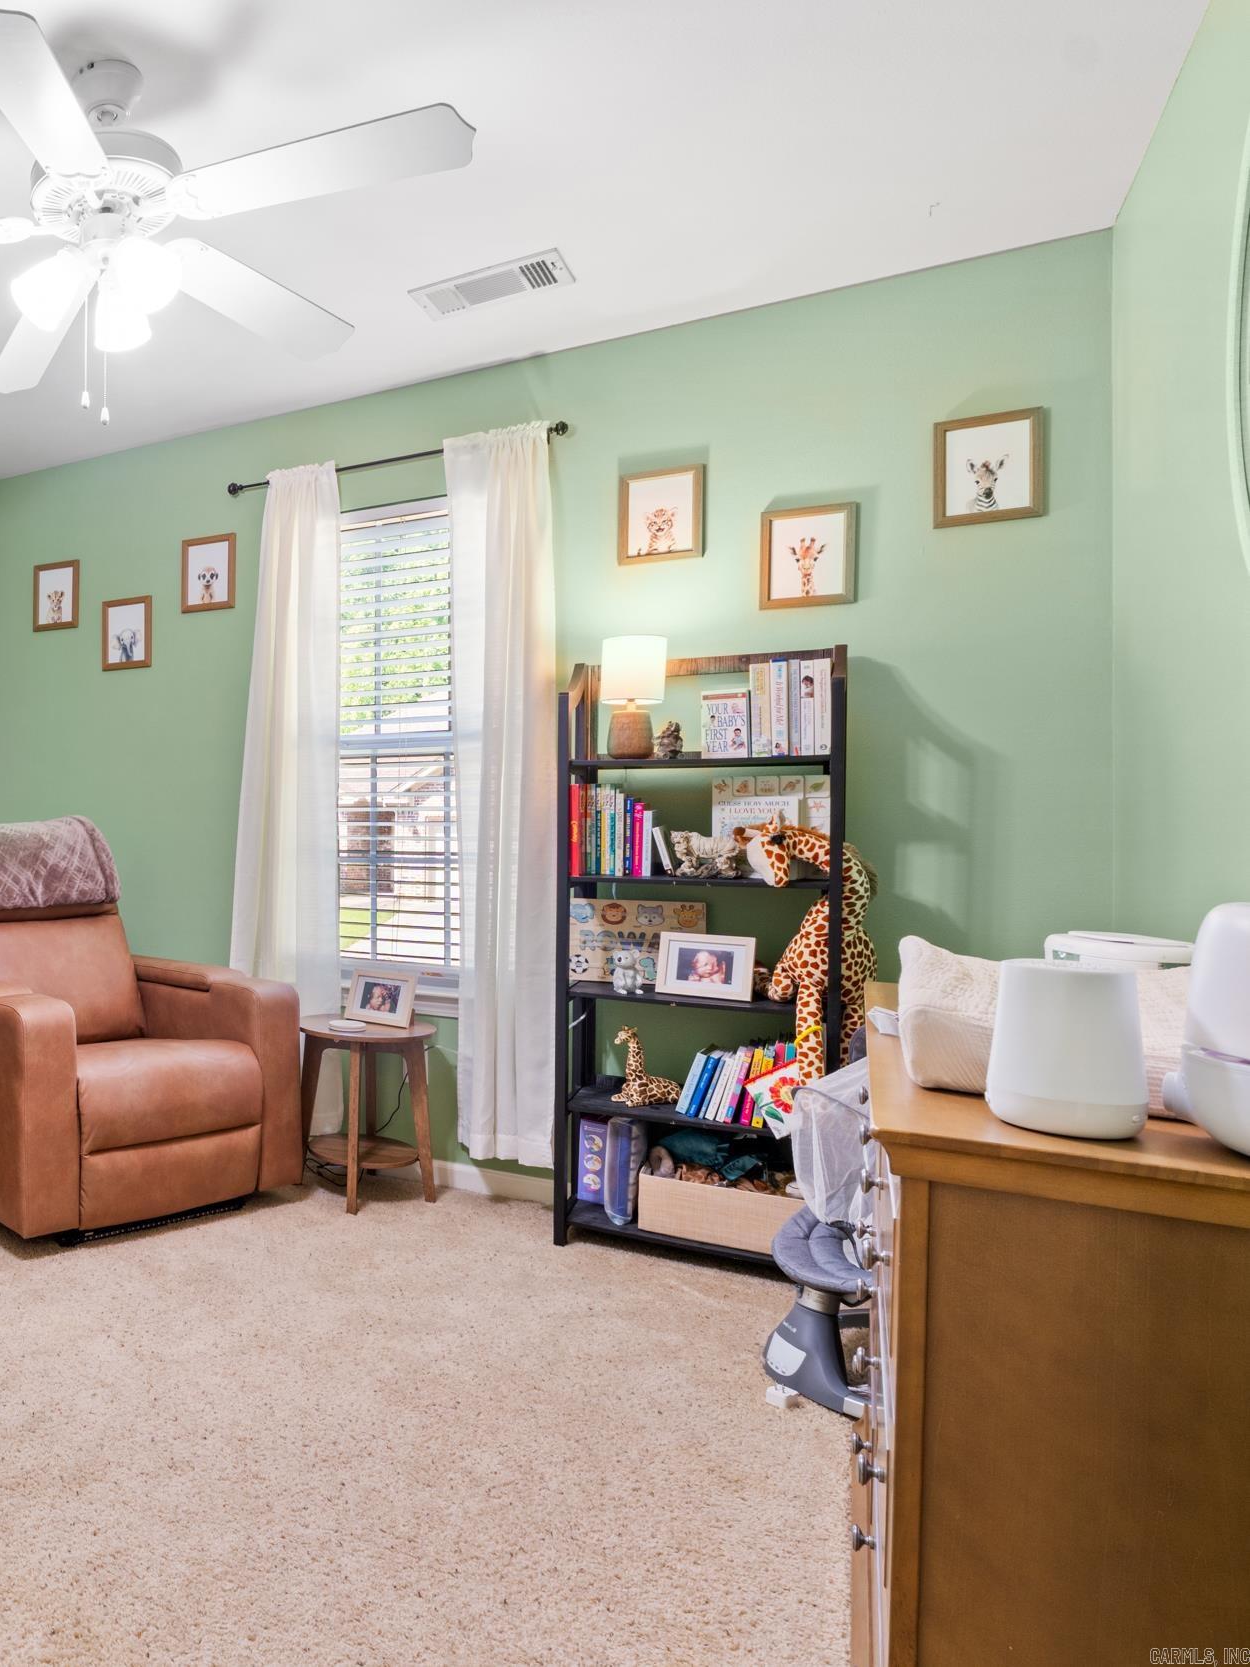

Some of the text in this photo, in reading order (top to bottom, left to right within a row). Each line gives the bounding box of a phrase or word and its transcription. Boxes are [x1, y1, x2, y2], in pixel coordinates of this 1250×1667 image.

[706, 702, 729, 716] YOUR
[717, 714, 746, 728] BABY'S
[705, 728, 728, 741] FIRST
[706, 741, 729, 753] YEAR
